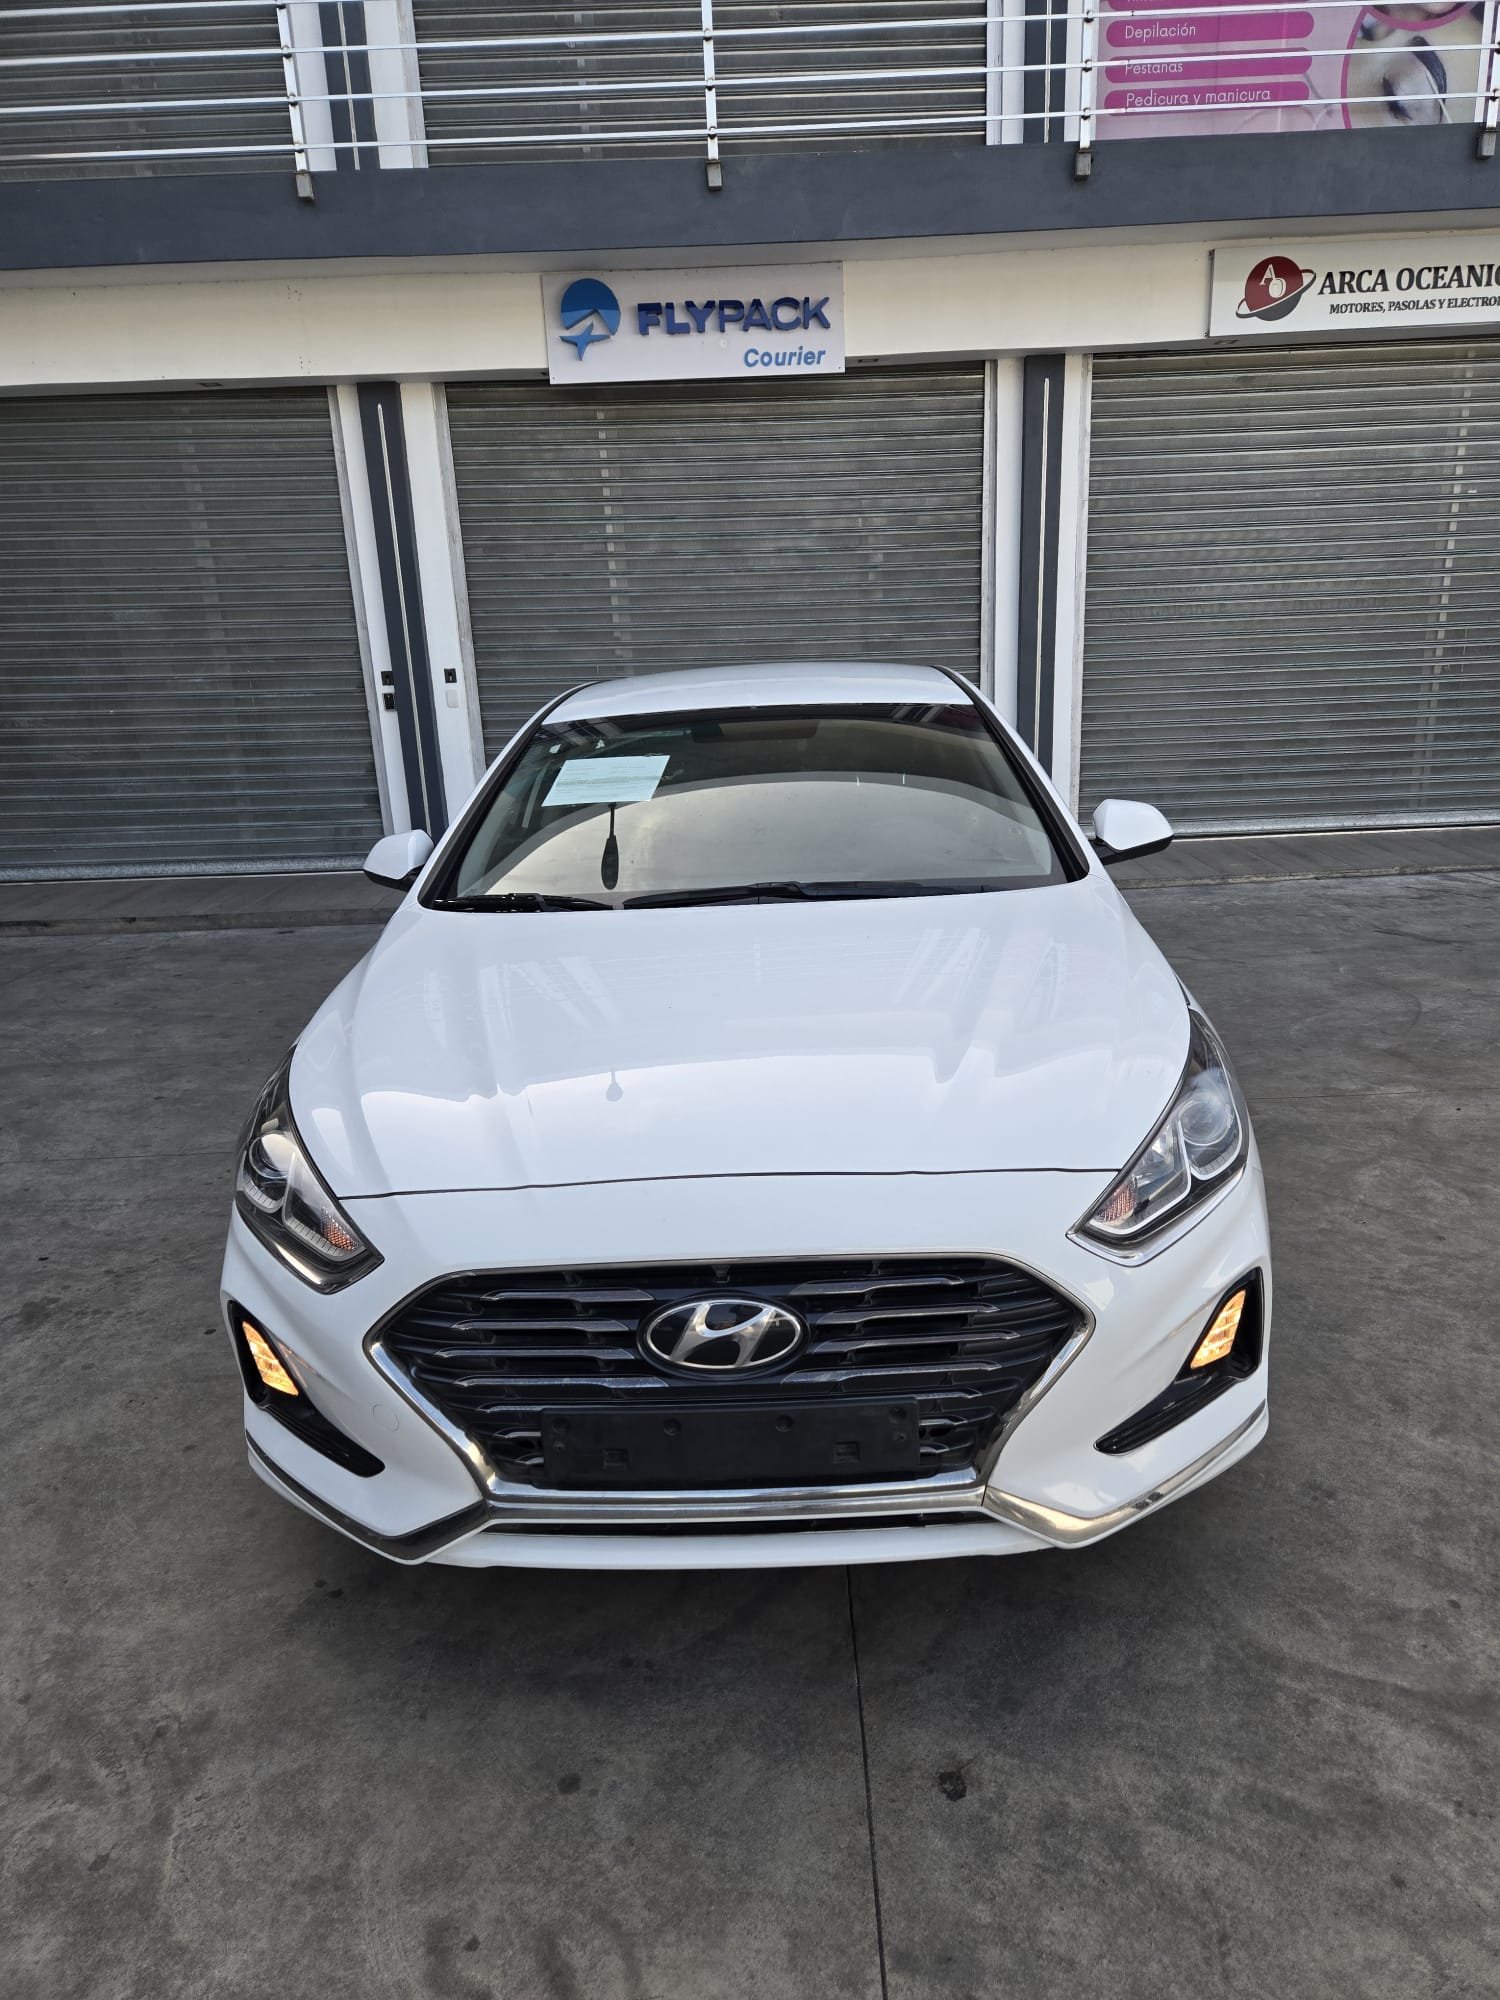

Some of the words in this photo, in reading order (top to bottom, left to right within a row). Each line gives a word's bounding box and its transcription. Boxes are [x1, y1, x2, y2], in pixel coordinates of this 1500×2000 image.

[1125, 21, 1196, 42] Depilación
[1126, 89, 1189, 107] Pedicura
[1193, 93, 1201, 105] y
[1205, 88, 1271, 104] manicura
[1317, 269, 1390, 295] ARCA
[1396, 263, 1500, 291] OCEANI
[1329, 301, 1386, 315] MOTORES,
[1388, 298, 1437, 312] PASOLAS
[1437, 298, 1446, 310] Y
[1447, 295, 1500, 309] ELECTRO
[637, 297, 831, 336] FLYPACK
[743, 346, 826, 367] Courier
